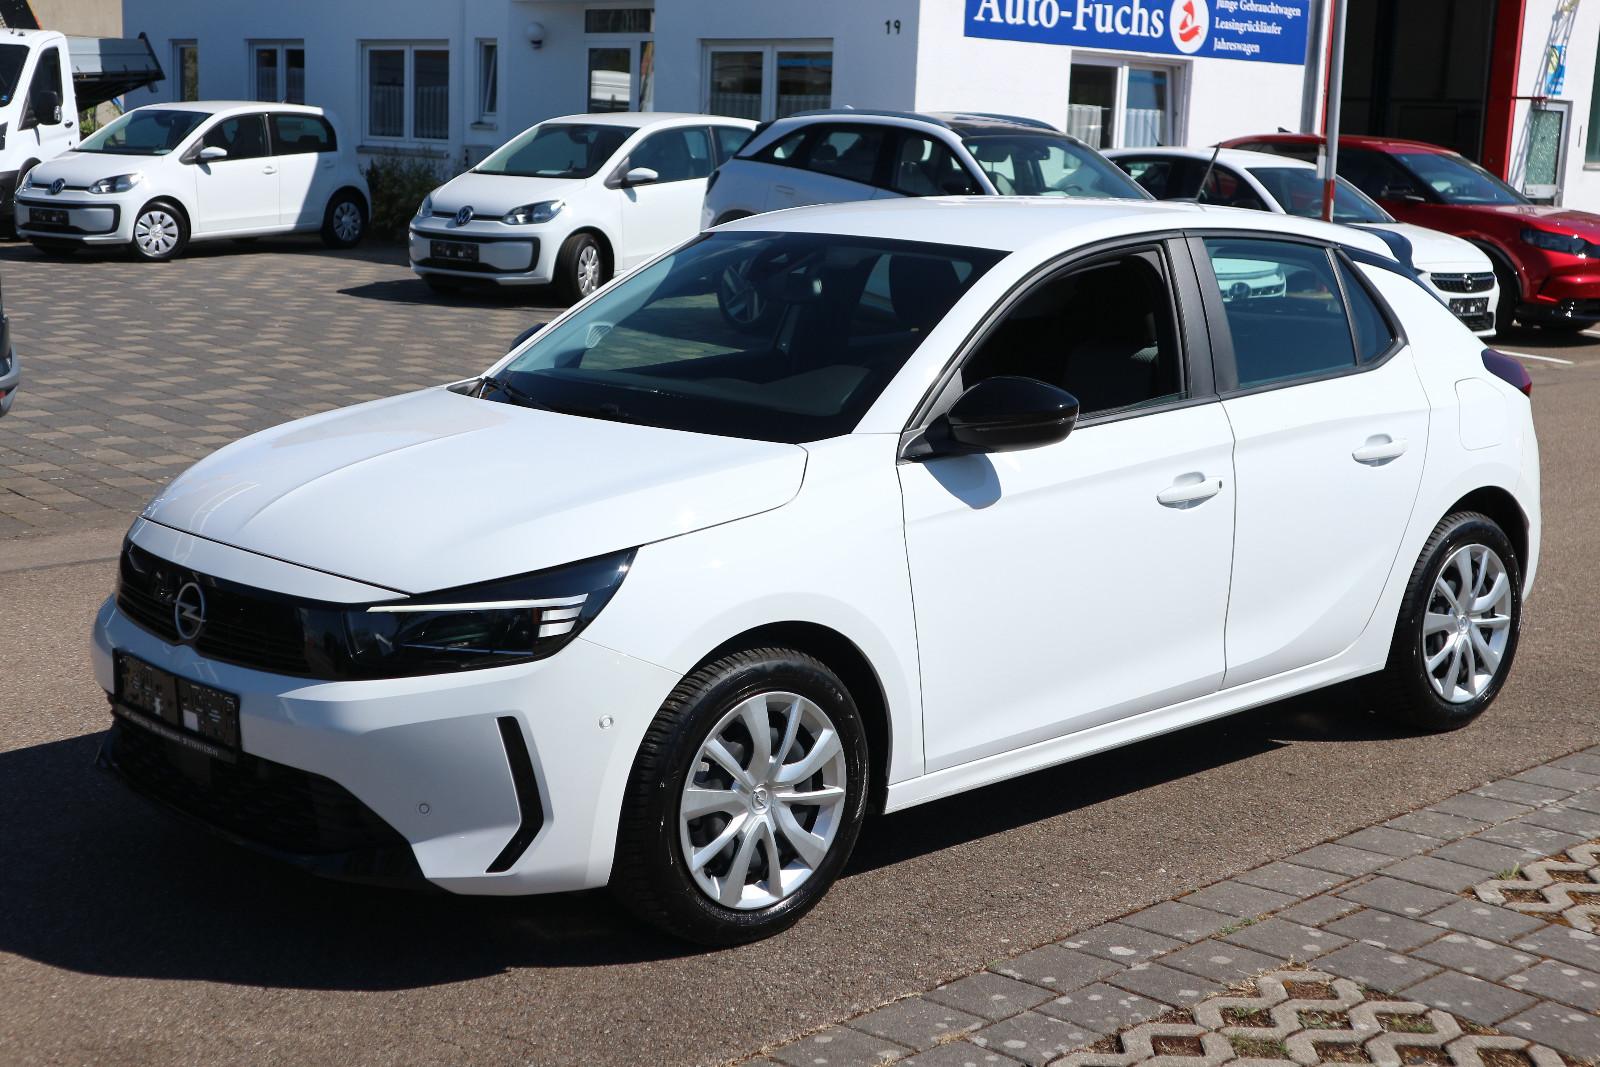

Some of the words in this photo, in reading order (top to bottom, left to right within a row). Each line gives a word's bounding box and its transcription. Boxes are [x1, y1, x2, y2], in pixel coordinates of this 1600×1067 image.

[973, 0, 1165, 38] Auto-Fuchs
[1240, 0, 1301, 19] Gebrauchtwagen
[885, 19, 901, 35] 19
[1215, 16, 1282, 35] Leasingrückläufer
[1213, 37, 1260, 55] Jahreswagen
